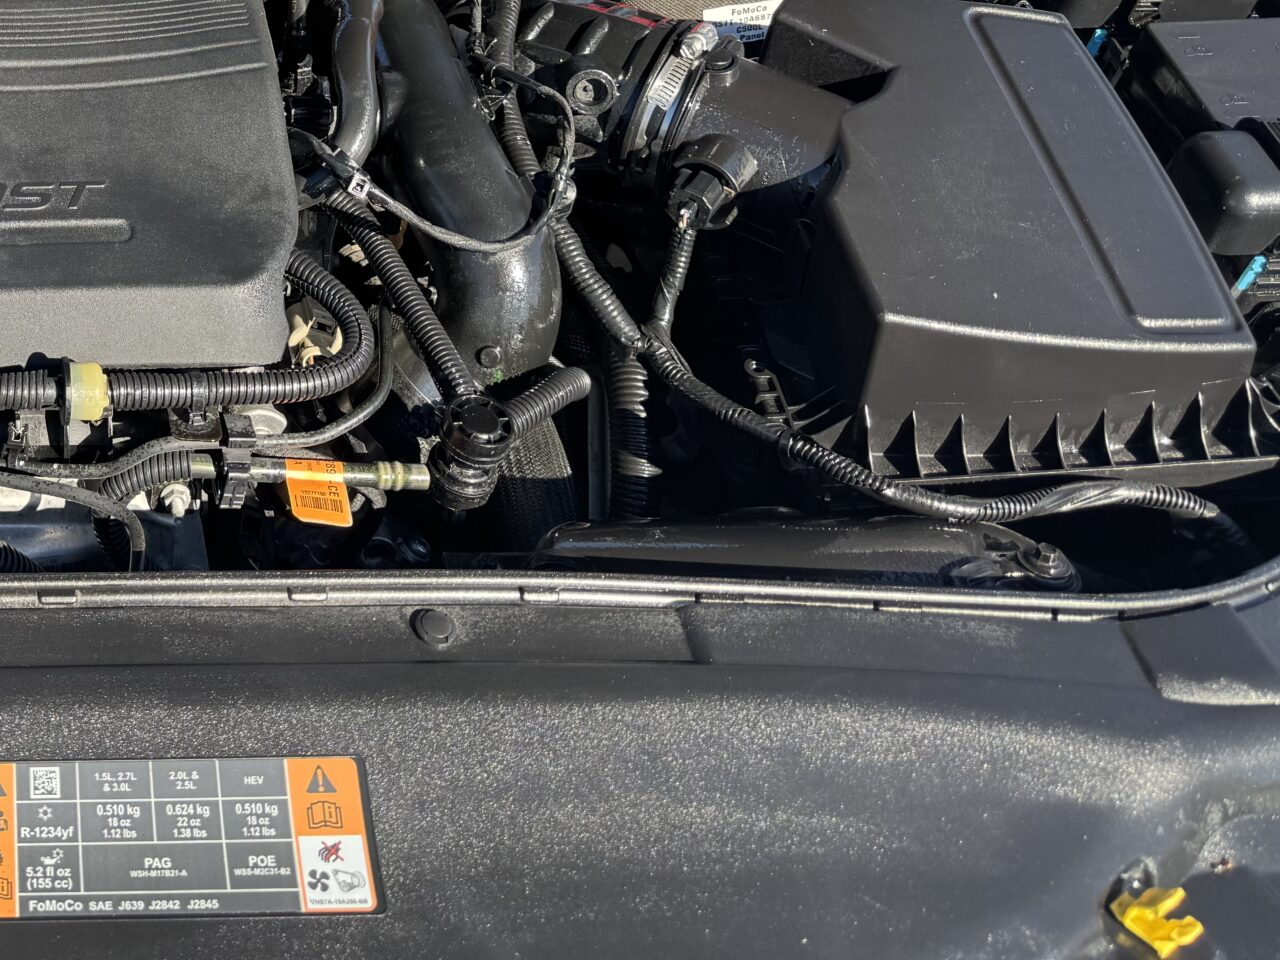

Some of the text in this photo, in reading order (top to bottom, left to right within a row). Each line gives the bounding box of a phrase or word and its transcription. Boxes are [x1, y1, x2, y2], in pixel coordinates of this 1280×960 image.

[731, 5, 768, 16] FoMoCo
[740, 32, 765, 41] Panel
[117, 772, 137, 781] 2.7L
[169, 771, 199, 780] 2.0L &
[244, 775, 264, 785] HEV
[103, 782, 132, 792] & 3.0L
[176, 781, 197, 790] 2.5L
[96, 804, 140, 818] 0.510 kg
[166, 803, 210, 818] 0.624 kg
[235, 803, 279, 817] 0.510 kg
[107, 818, 131, 827] 18 oz
[177, 817, 201, 827] 22 oz
[246, 816, 270, 826] 18 oz
[21, 826, 75, 840] R-1234yf
[102, 828, 137, 838] 1.12 lbs
[172, 828, 207, 838] 1.38 lbs
[242, 827, 276, 837] 1.12 lbs
[144, 858, 172, 869] PAG
[248, 855, 277, 867] POE
[26, 867, 71, 878] 5.2 fl oz
[27, 877, 73, 890] (155 cc)
[29, 899, 219, 912] FoMoCo SAE J639 J2842 J2845
